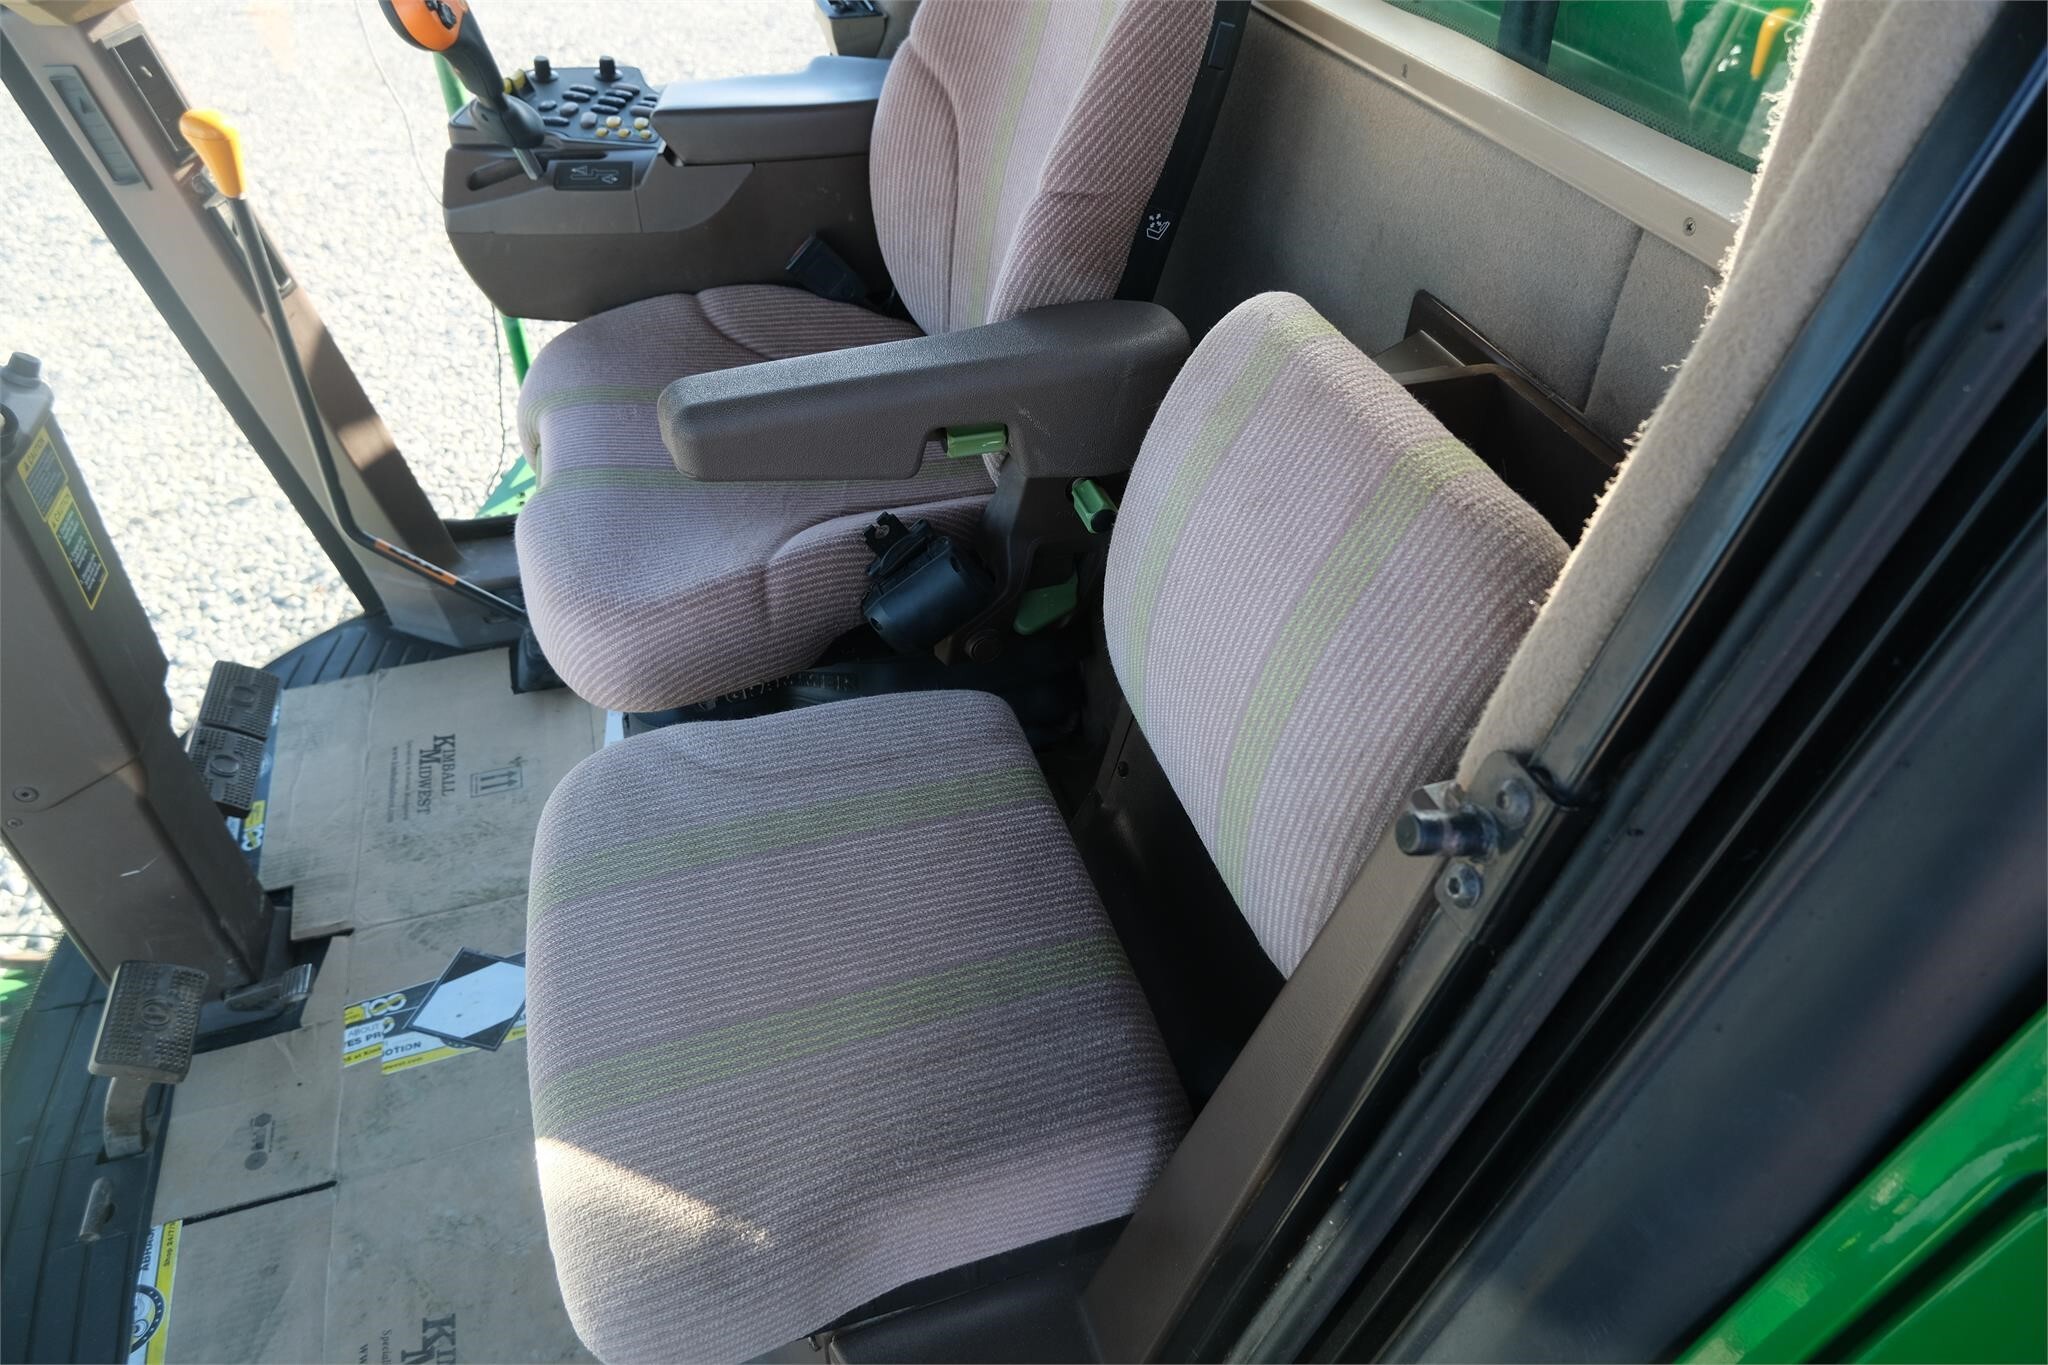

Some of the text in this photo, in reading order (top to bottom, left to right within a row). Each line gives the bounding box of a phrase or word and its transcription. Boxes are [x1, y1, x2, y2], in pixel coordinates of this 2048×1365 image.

[433, 733, 456, 796] KIMBALL
[417, 749, 441, 815] MIDWEST
[362, 993, 407, 1019] 100
[348, 1022, 381, 1038] ABOUT
[383, 1041, 422, 1057] OTION
[163, 1247, 173, 1267] Shop
